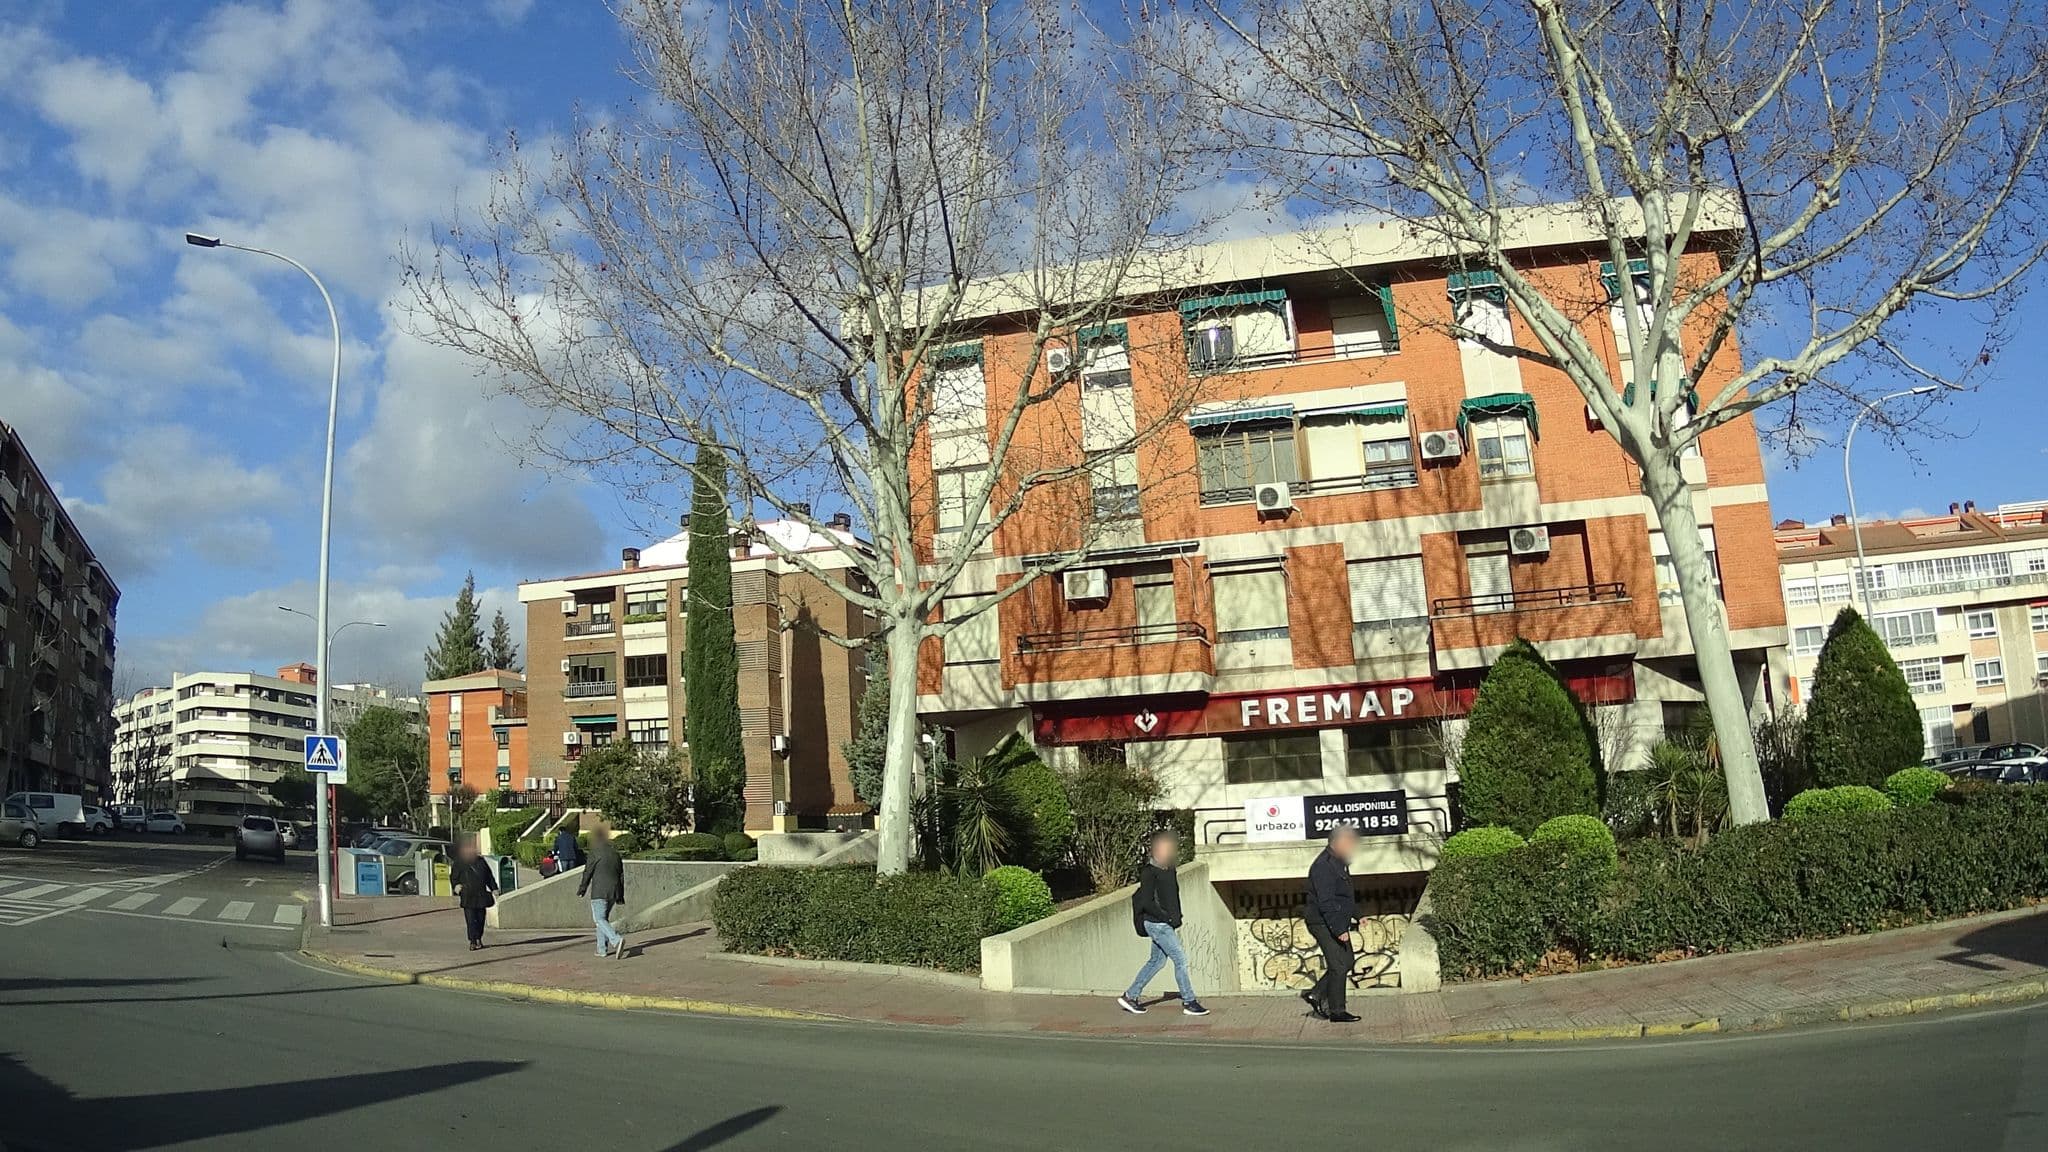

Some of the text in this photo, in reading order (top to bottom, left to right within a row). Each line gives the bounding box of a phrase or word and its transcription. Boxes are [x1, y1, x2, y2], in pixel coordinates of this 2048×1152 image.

[1240, 687, 1414, 727] FREMAP
[1314, 800, 1397, 815] LOCAL DISPONIBLE
[1255, 821, 1297, 831] urbazo
[1362, 815, 1379, 829] 18
[1381, 814, 1399, 828] 58
